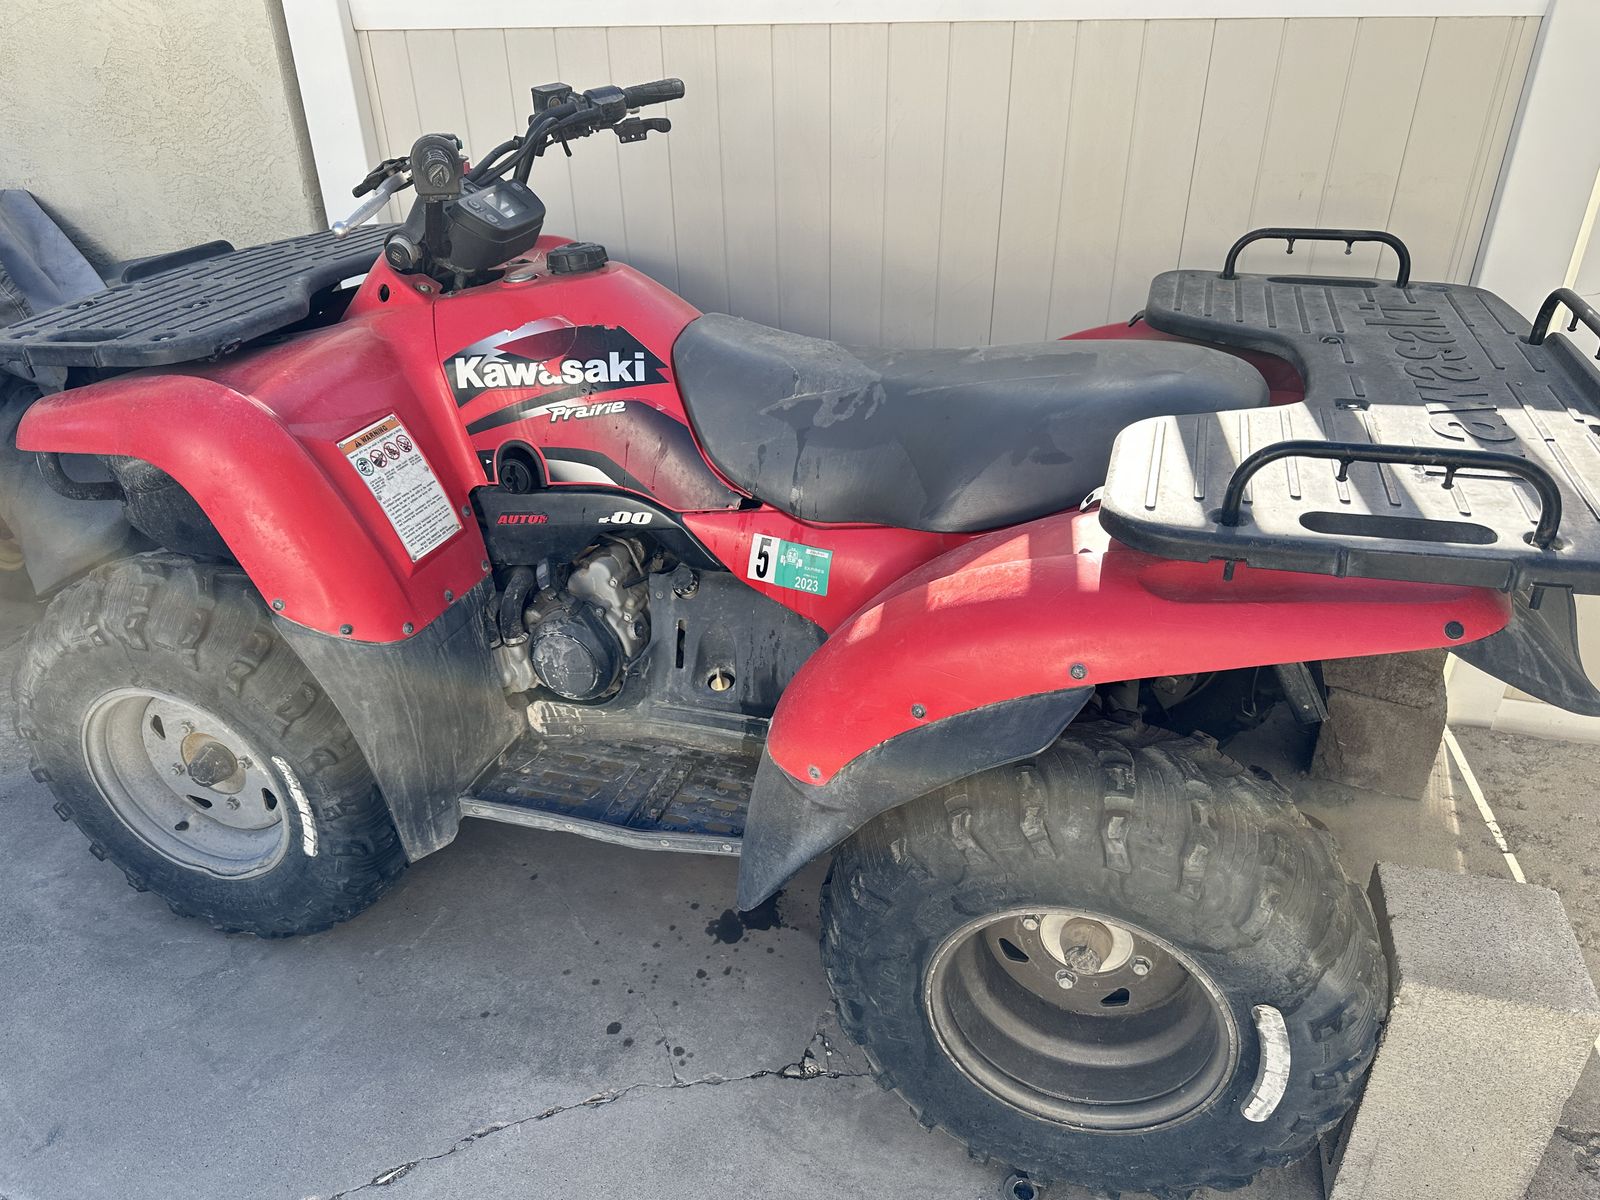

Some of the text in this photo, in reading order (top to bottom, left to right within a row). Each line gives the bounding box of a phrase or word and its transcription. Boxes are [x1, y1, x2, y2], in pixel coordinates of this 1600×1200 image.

[454, 351, 646, 390] Kawasaki
[549, 401, 627, 422] Prairie
[361, 425, 389, 444] WARNING
[755, 537, 773, 579] 5
[794, 576, 819, 592] 2023
